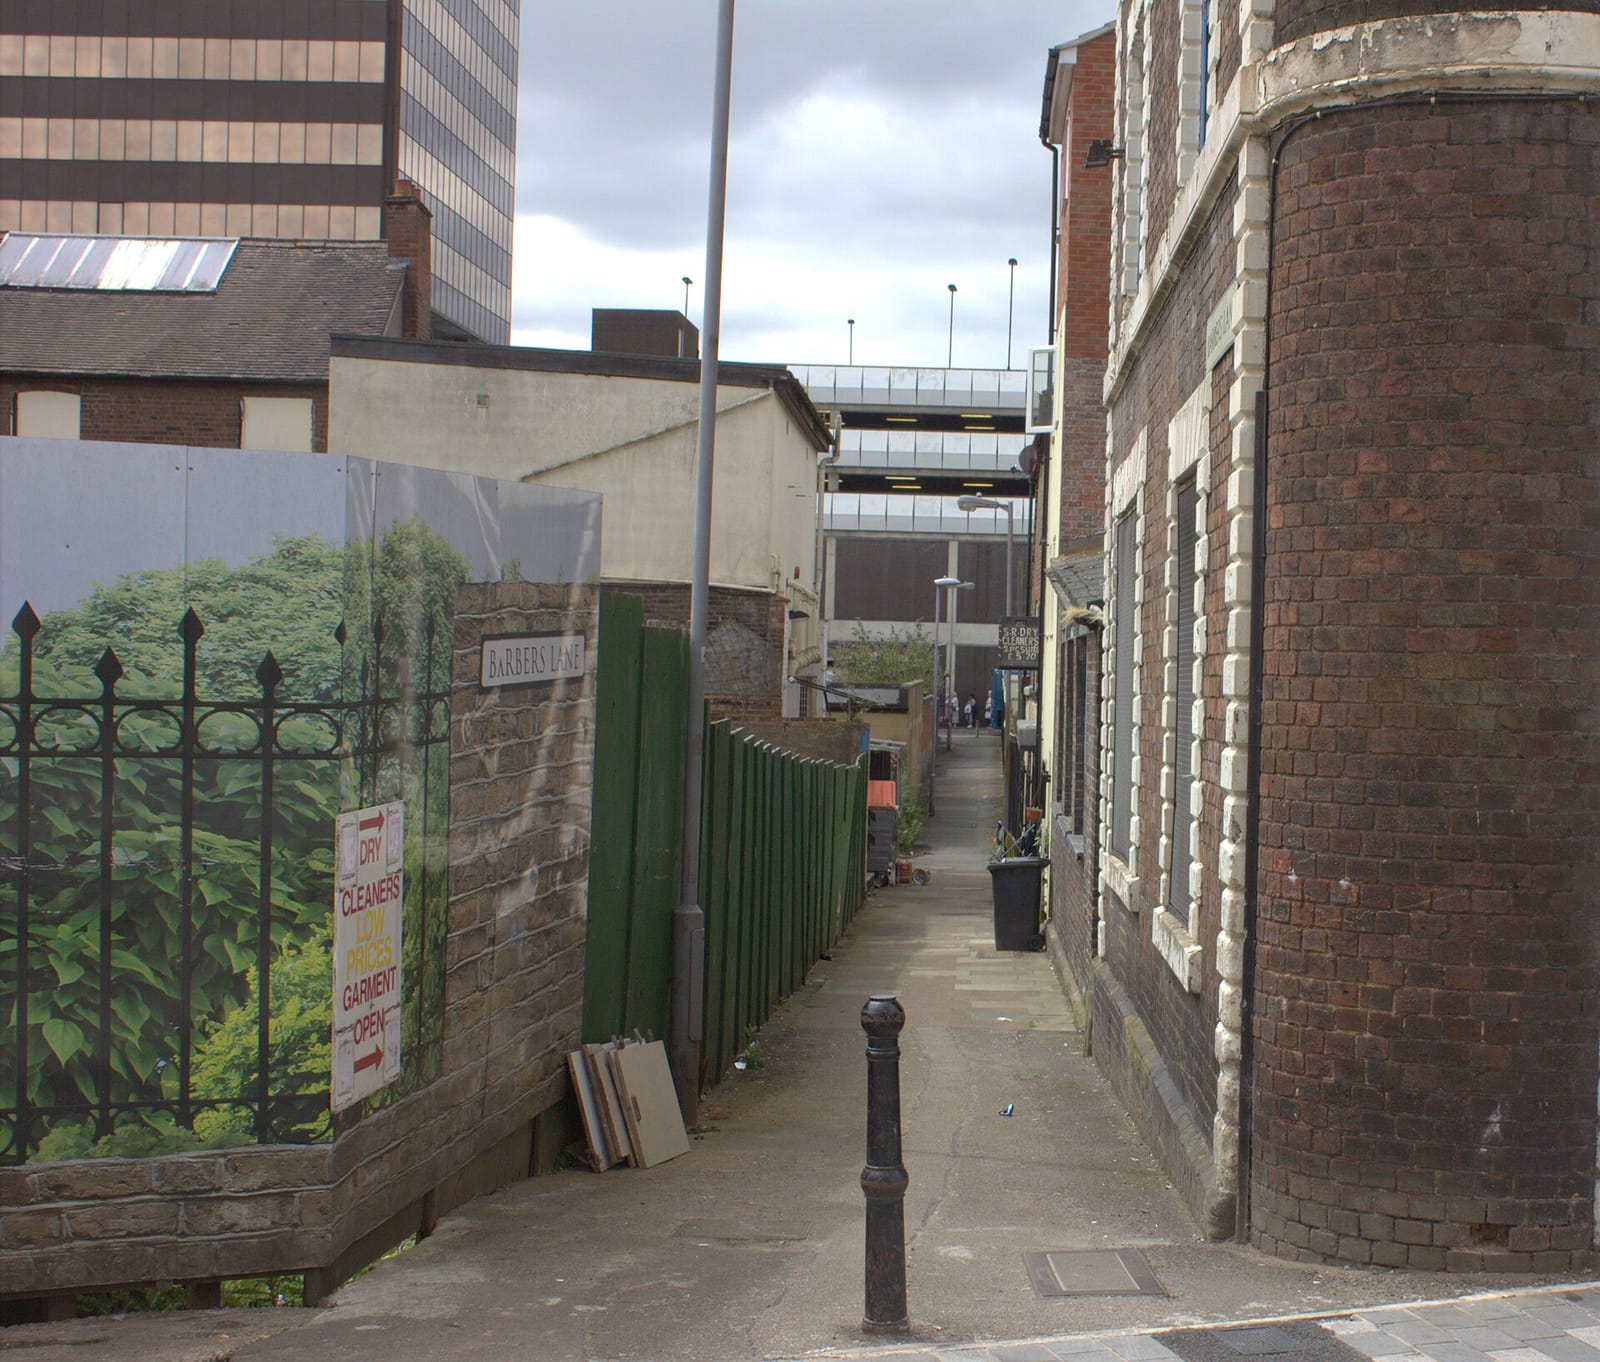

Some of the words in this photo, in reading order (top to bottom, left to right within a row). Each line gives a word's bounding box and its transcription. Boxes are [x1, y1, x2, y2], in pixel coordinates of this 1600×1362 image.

[1002, 637, 1039, 646] CLEANERS
[489, 646, 546, 678] BARBERS
[551, 643, 580, 672] LANE
[360, 836, 381, 866] DRY
[342, 875, 400, 917] CLEANERS
[356, 906, 385, 943] LOW
[346, 935, 392, 980] PRICES
[343, 965, 396, 1012] GARMENT
[353, 1008, 384, 1046] OPEN
